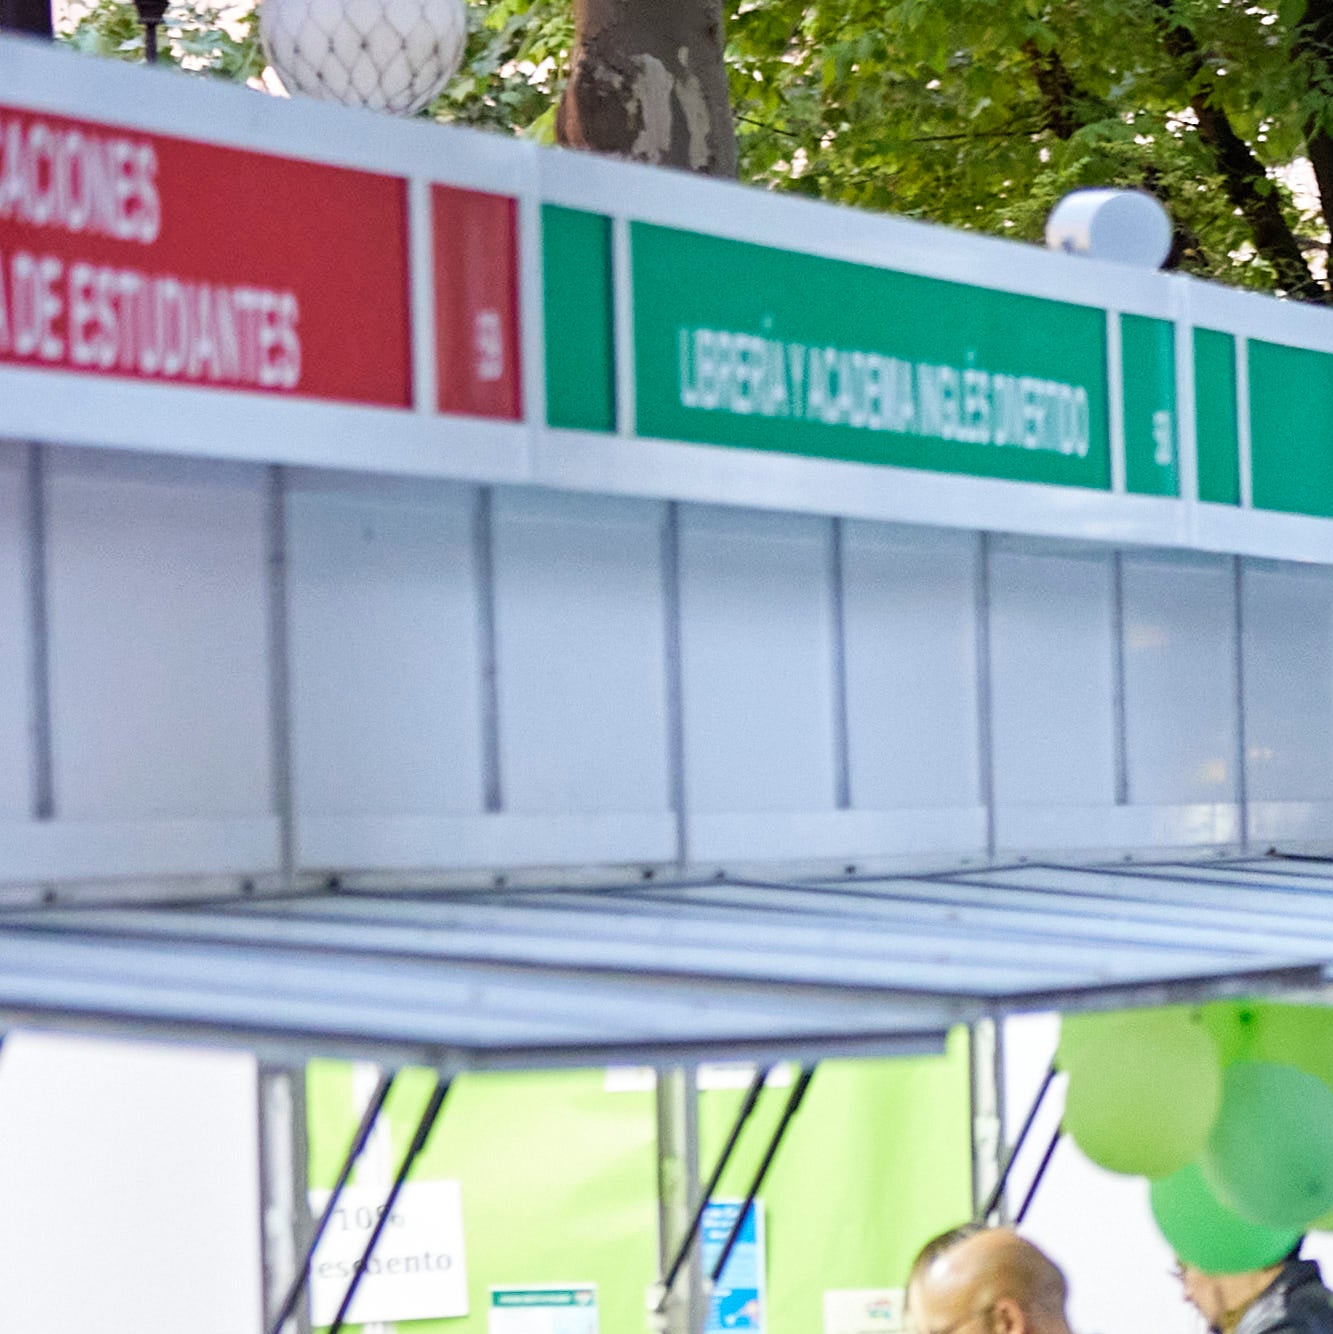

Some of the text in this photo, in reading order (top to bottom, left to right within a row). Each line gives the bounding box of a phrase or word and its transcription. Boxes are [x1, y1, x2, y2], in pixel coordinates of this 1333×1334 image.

[0, 119, 160, 245] ACIONES
[12, 252, 63, 361] DE
[69, 262, 302, 388] ESTUDIANTES
[680, 316, 788, 417] LIBRERÍA
[807, 346, 914, 433] ACADEMIA
[917, 348, 991, 445] INGLÉS
[992, 374, 1091, 459] DIVERTIDO
